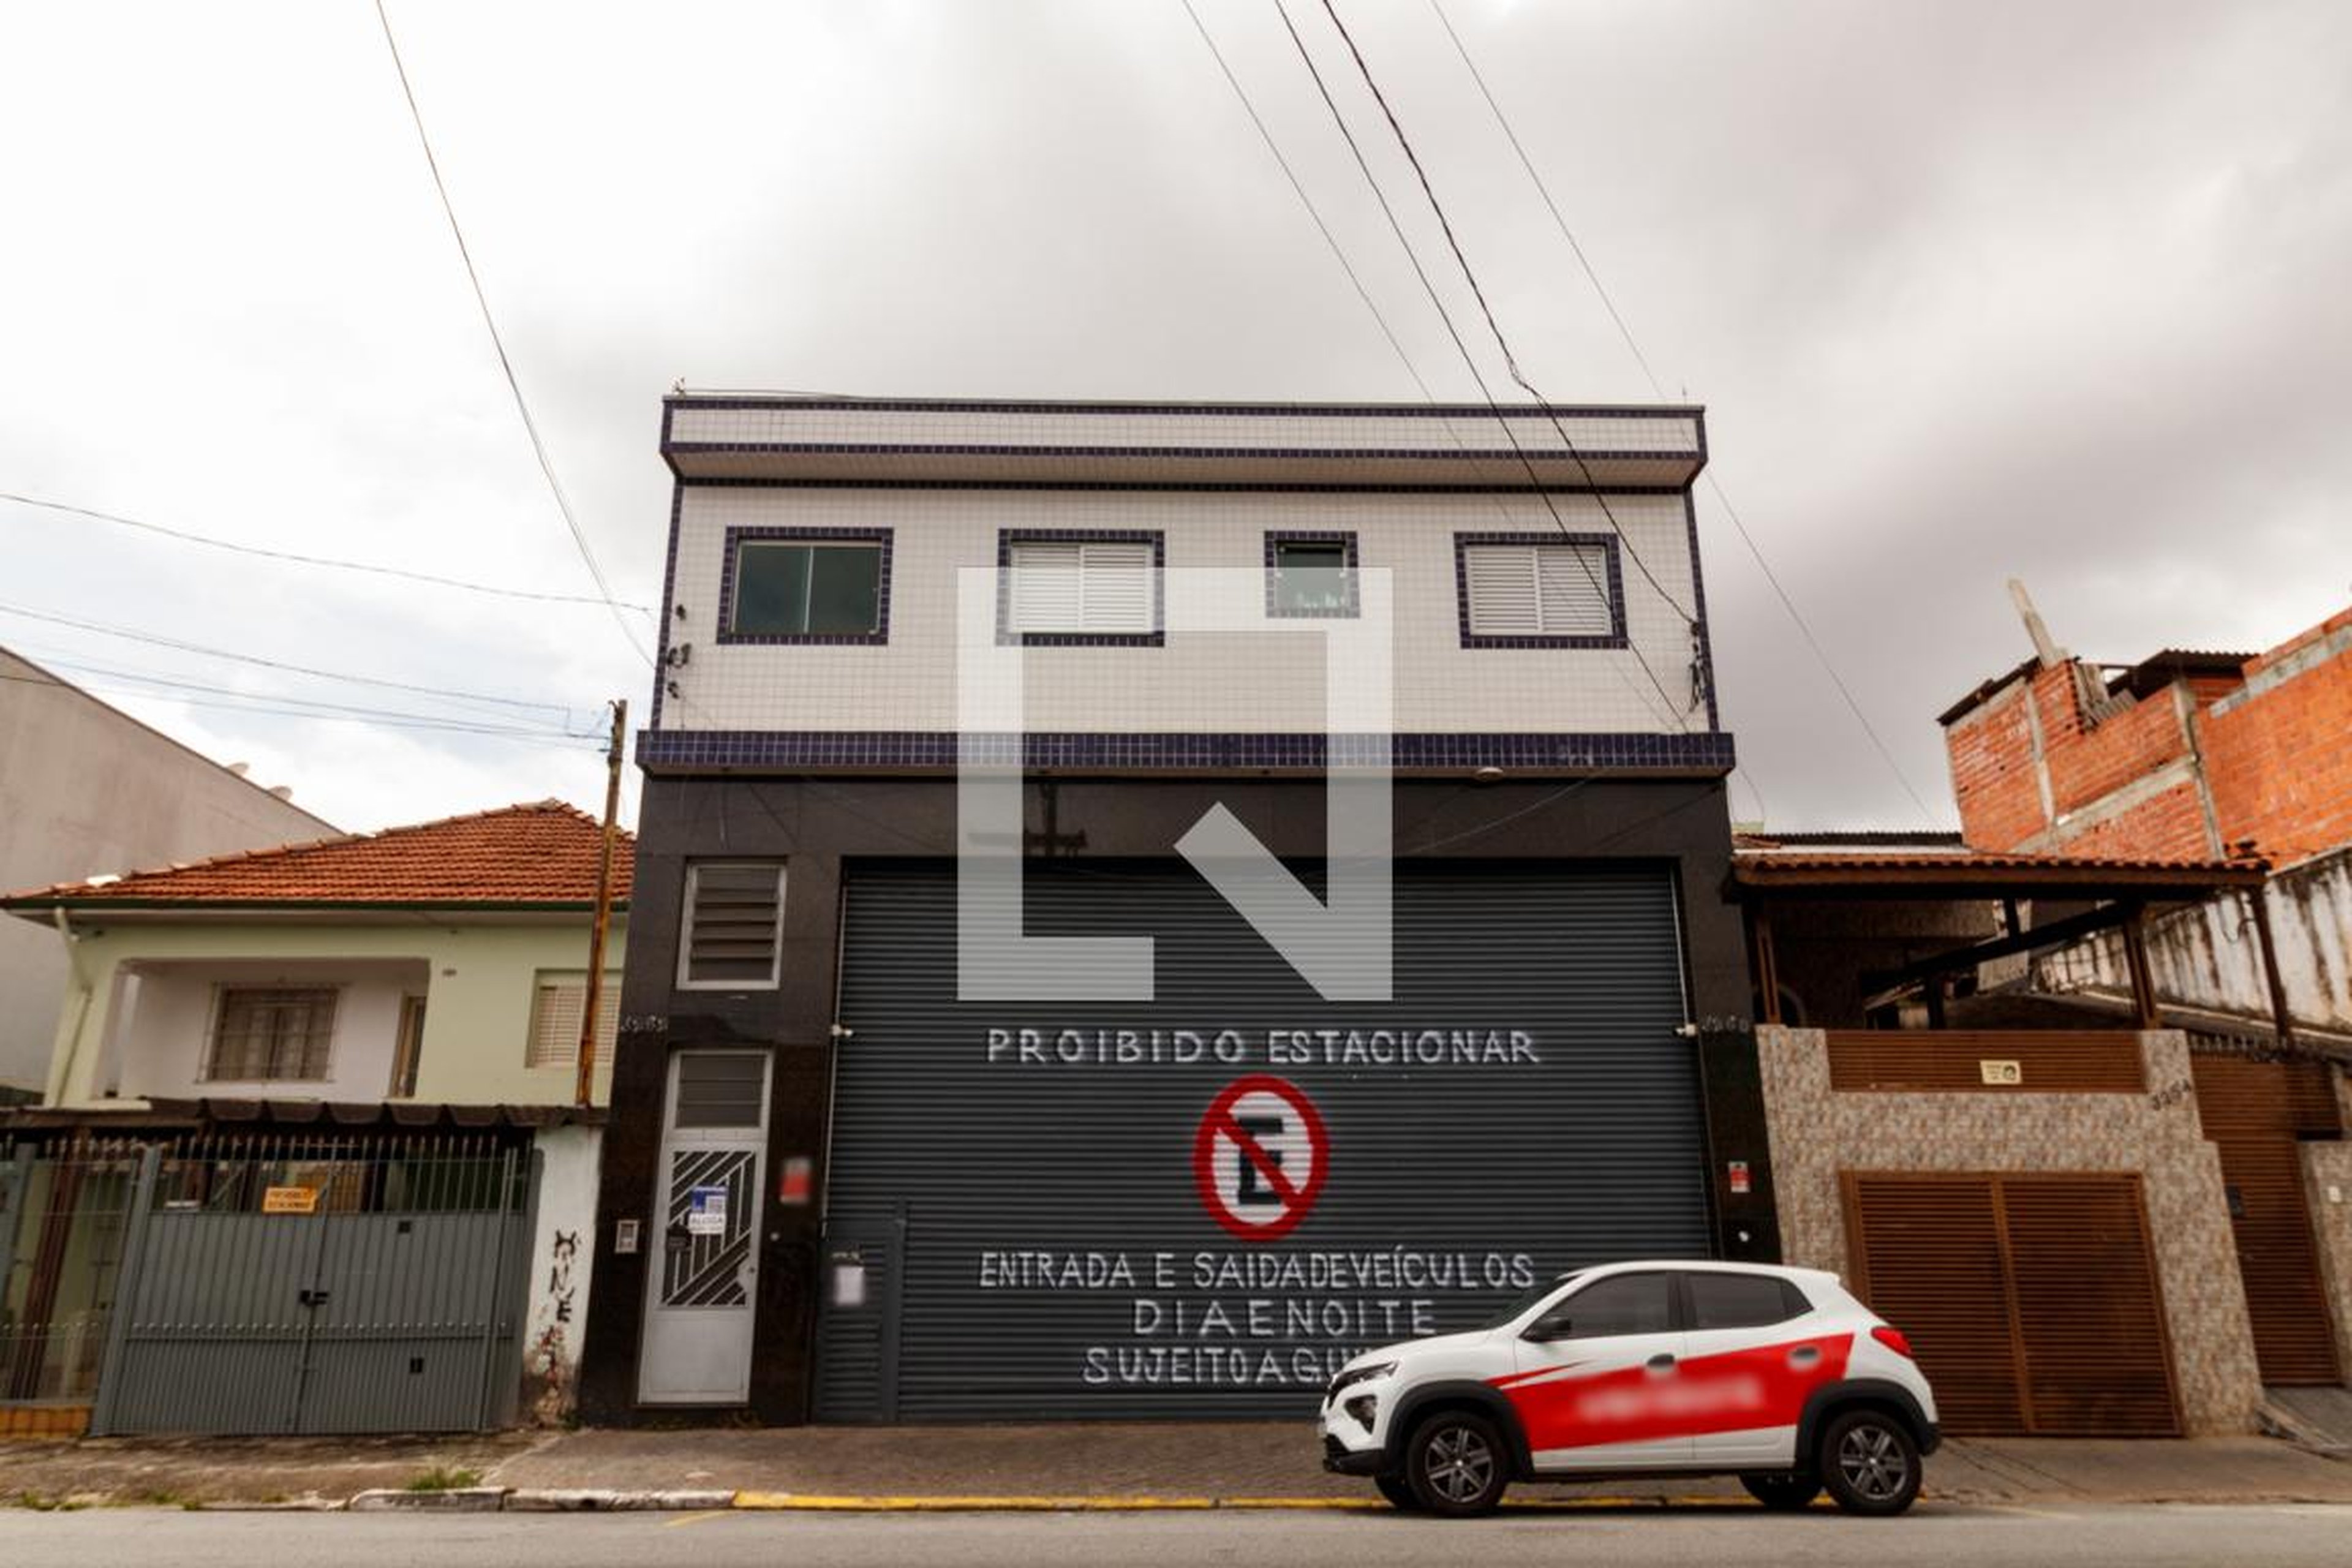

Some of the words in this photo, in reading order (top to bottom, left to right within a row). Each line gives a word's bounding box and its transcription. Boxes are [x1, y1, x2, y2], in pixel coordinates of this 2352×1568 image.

[987, 1028, 1245, 1063] PROIBIDO
[1268, 1030, 1540, 1063] ESTACIONAR
[979, 1252, 1136, 1287] ENTRADA
[1155, 1253, 1175, 1287] E
